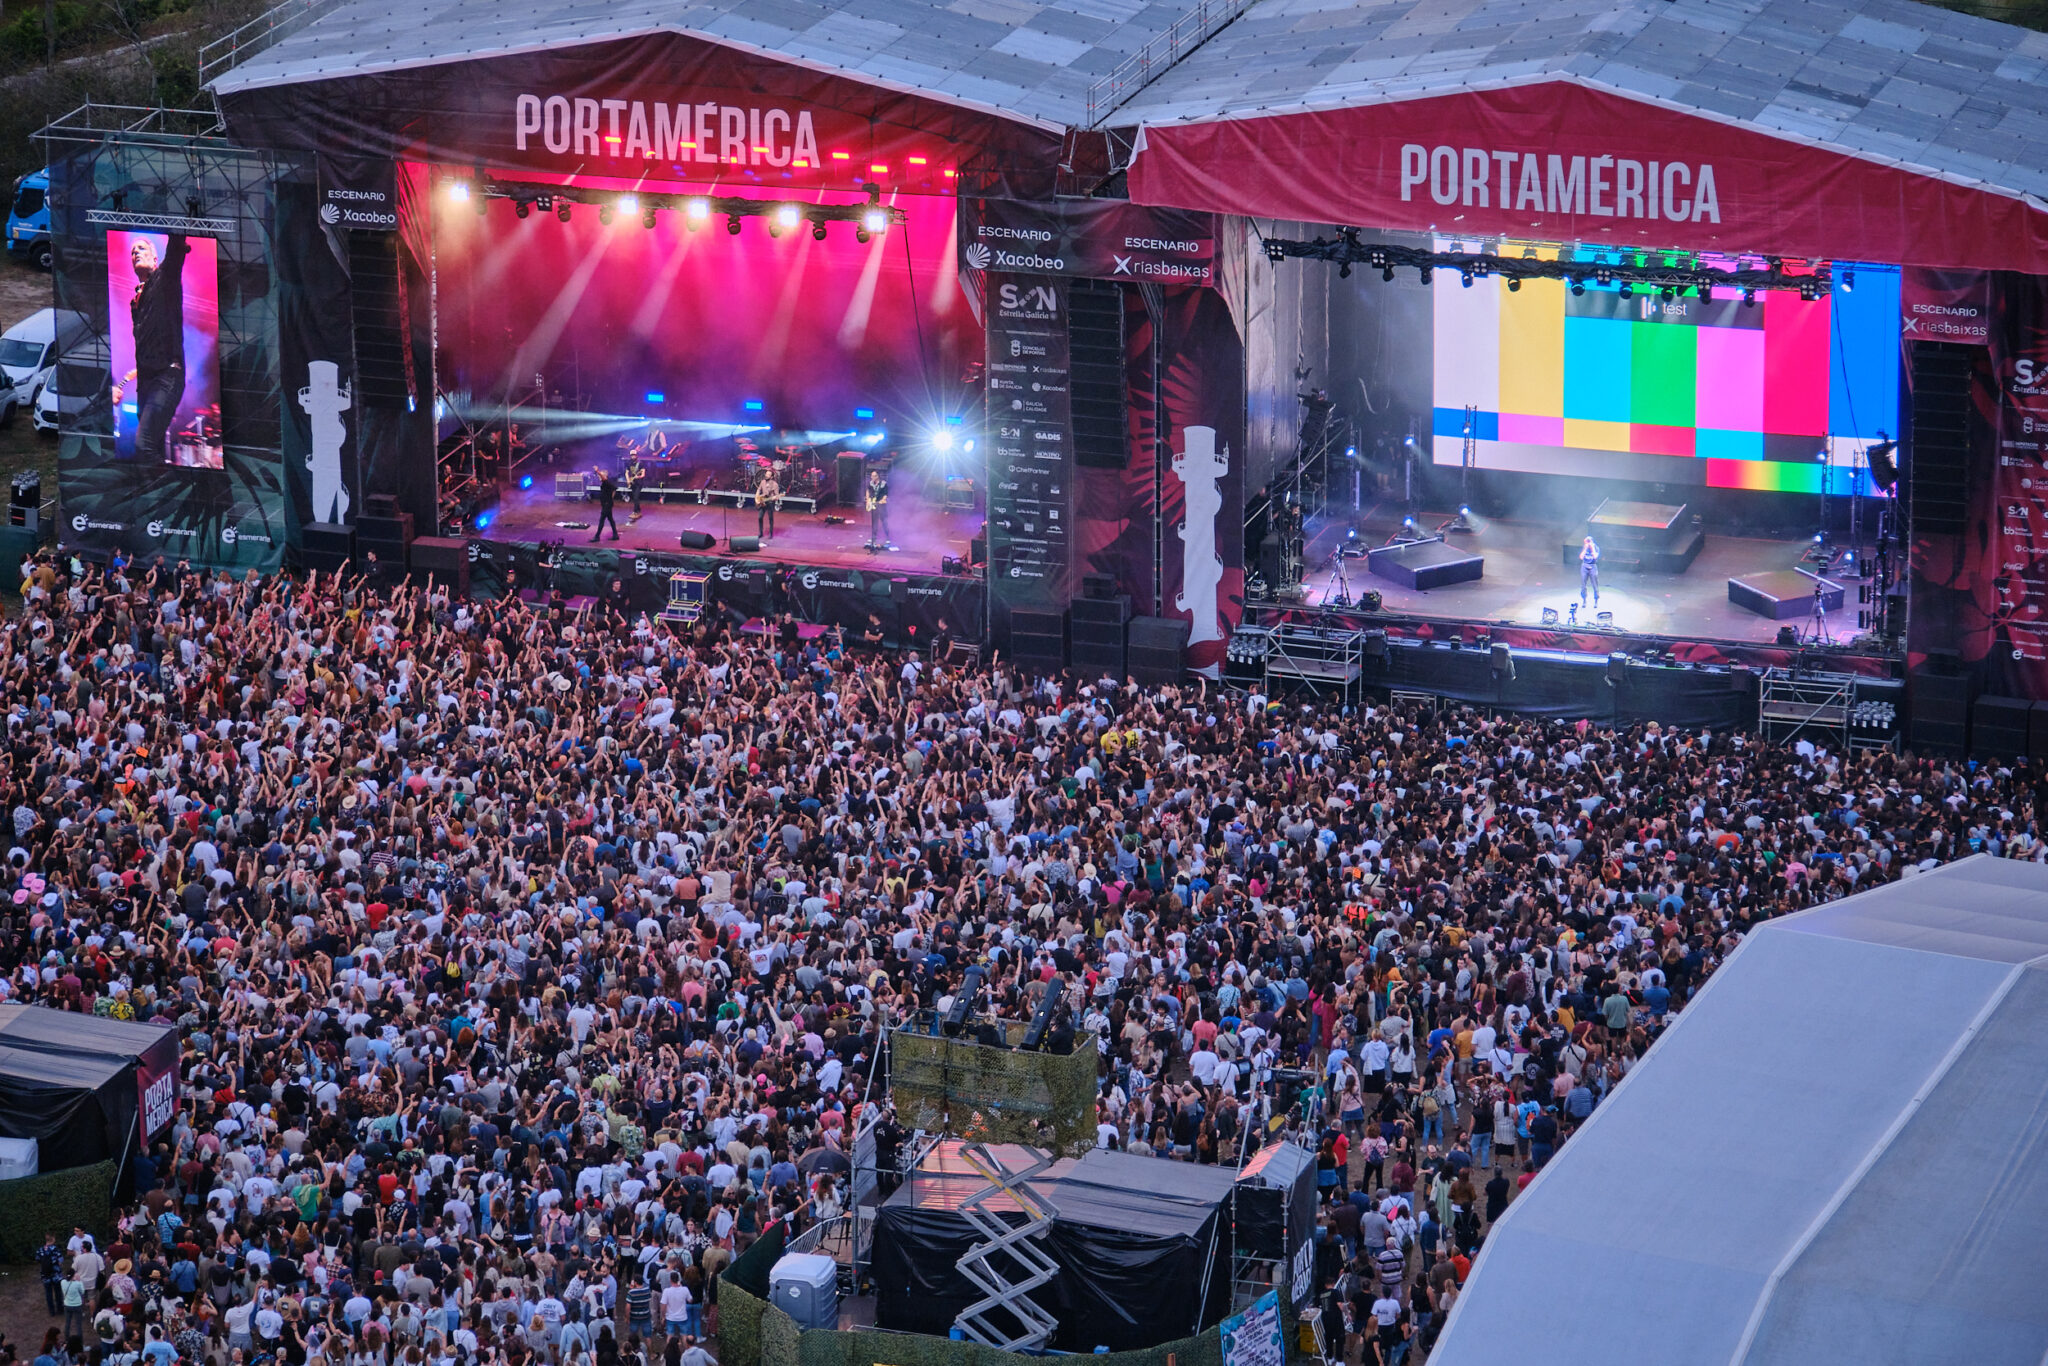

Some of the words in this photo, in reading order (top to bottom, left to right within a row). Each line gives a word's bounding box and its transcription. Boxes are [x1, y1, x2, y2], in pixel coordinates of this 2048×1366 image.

[516, 94, 820, 168] PORTAMÉRICA
[1401, 144, 1720, 224] PORTAMÉRICA
[328, 190, 385, 201] ESCENARIO
[343, 208, 396, 224] Xacobeo
[978, 226, 1051, 241] ESCENARIO
[1125, 237, 1199, 253] ESCENARIO
[995, 250, 1064, 270] Xacobeo
[1025, 311, 1049, 319] Galicia
[1662, 302, 1687, 316] test
[1913, 304, 1978, 317] ESCENARIO
[1035, 432, 1061, 441] GADIS
[819, 579, 855, 589] esmerarte
[145, 1071, 173, 1115] PORTA
